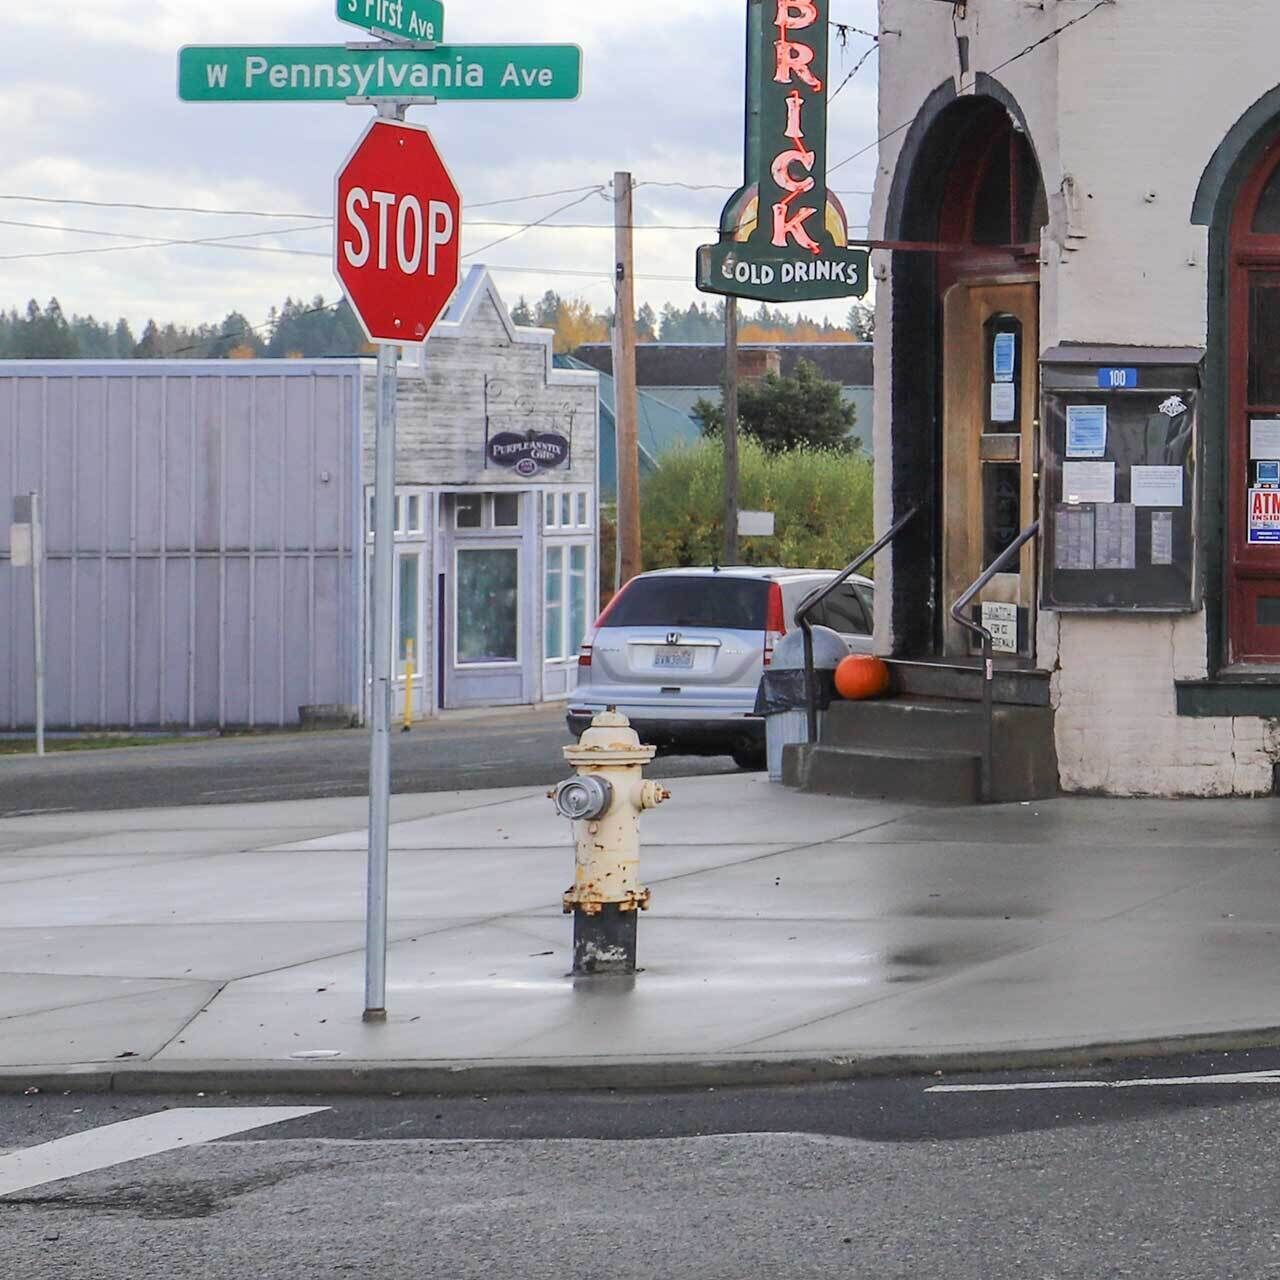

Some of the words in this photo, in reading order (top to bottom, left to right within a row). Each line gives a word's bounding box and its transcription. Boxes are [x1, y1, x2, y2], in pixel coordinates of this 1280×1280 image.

[408, 13, 435, 40] Ave
[206, 64, 228, 87] W
[245, 55, 484, 96] Pennsylvania
[500, 62, 553, 87] Ave
[343, 185, 454, 277] STOP
[721, 257, 774, 285] COLD
[781, 259, 860, 285] DRINKS
[1109, 369, 1126, 386] 100
